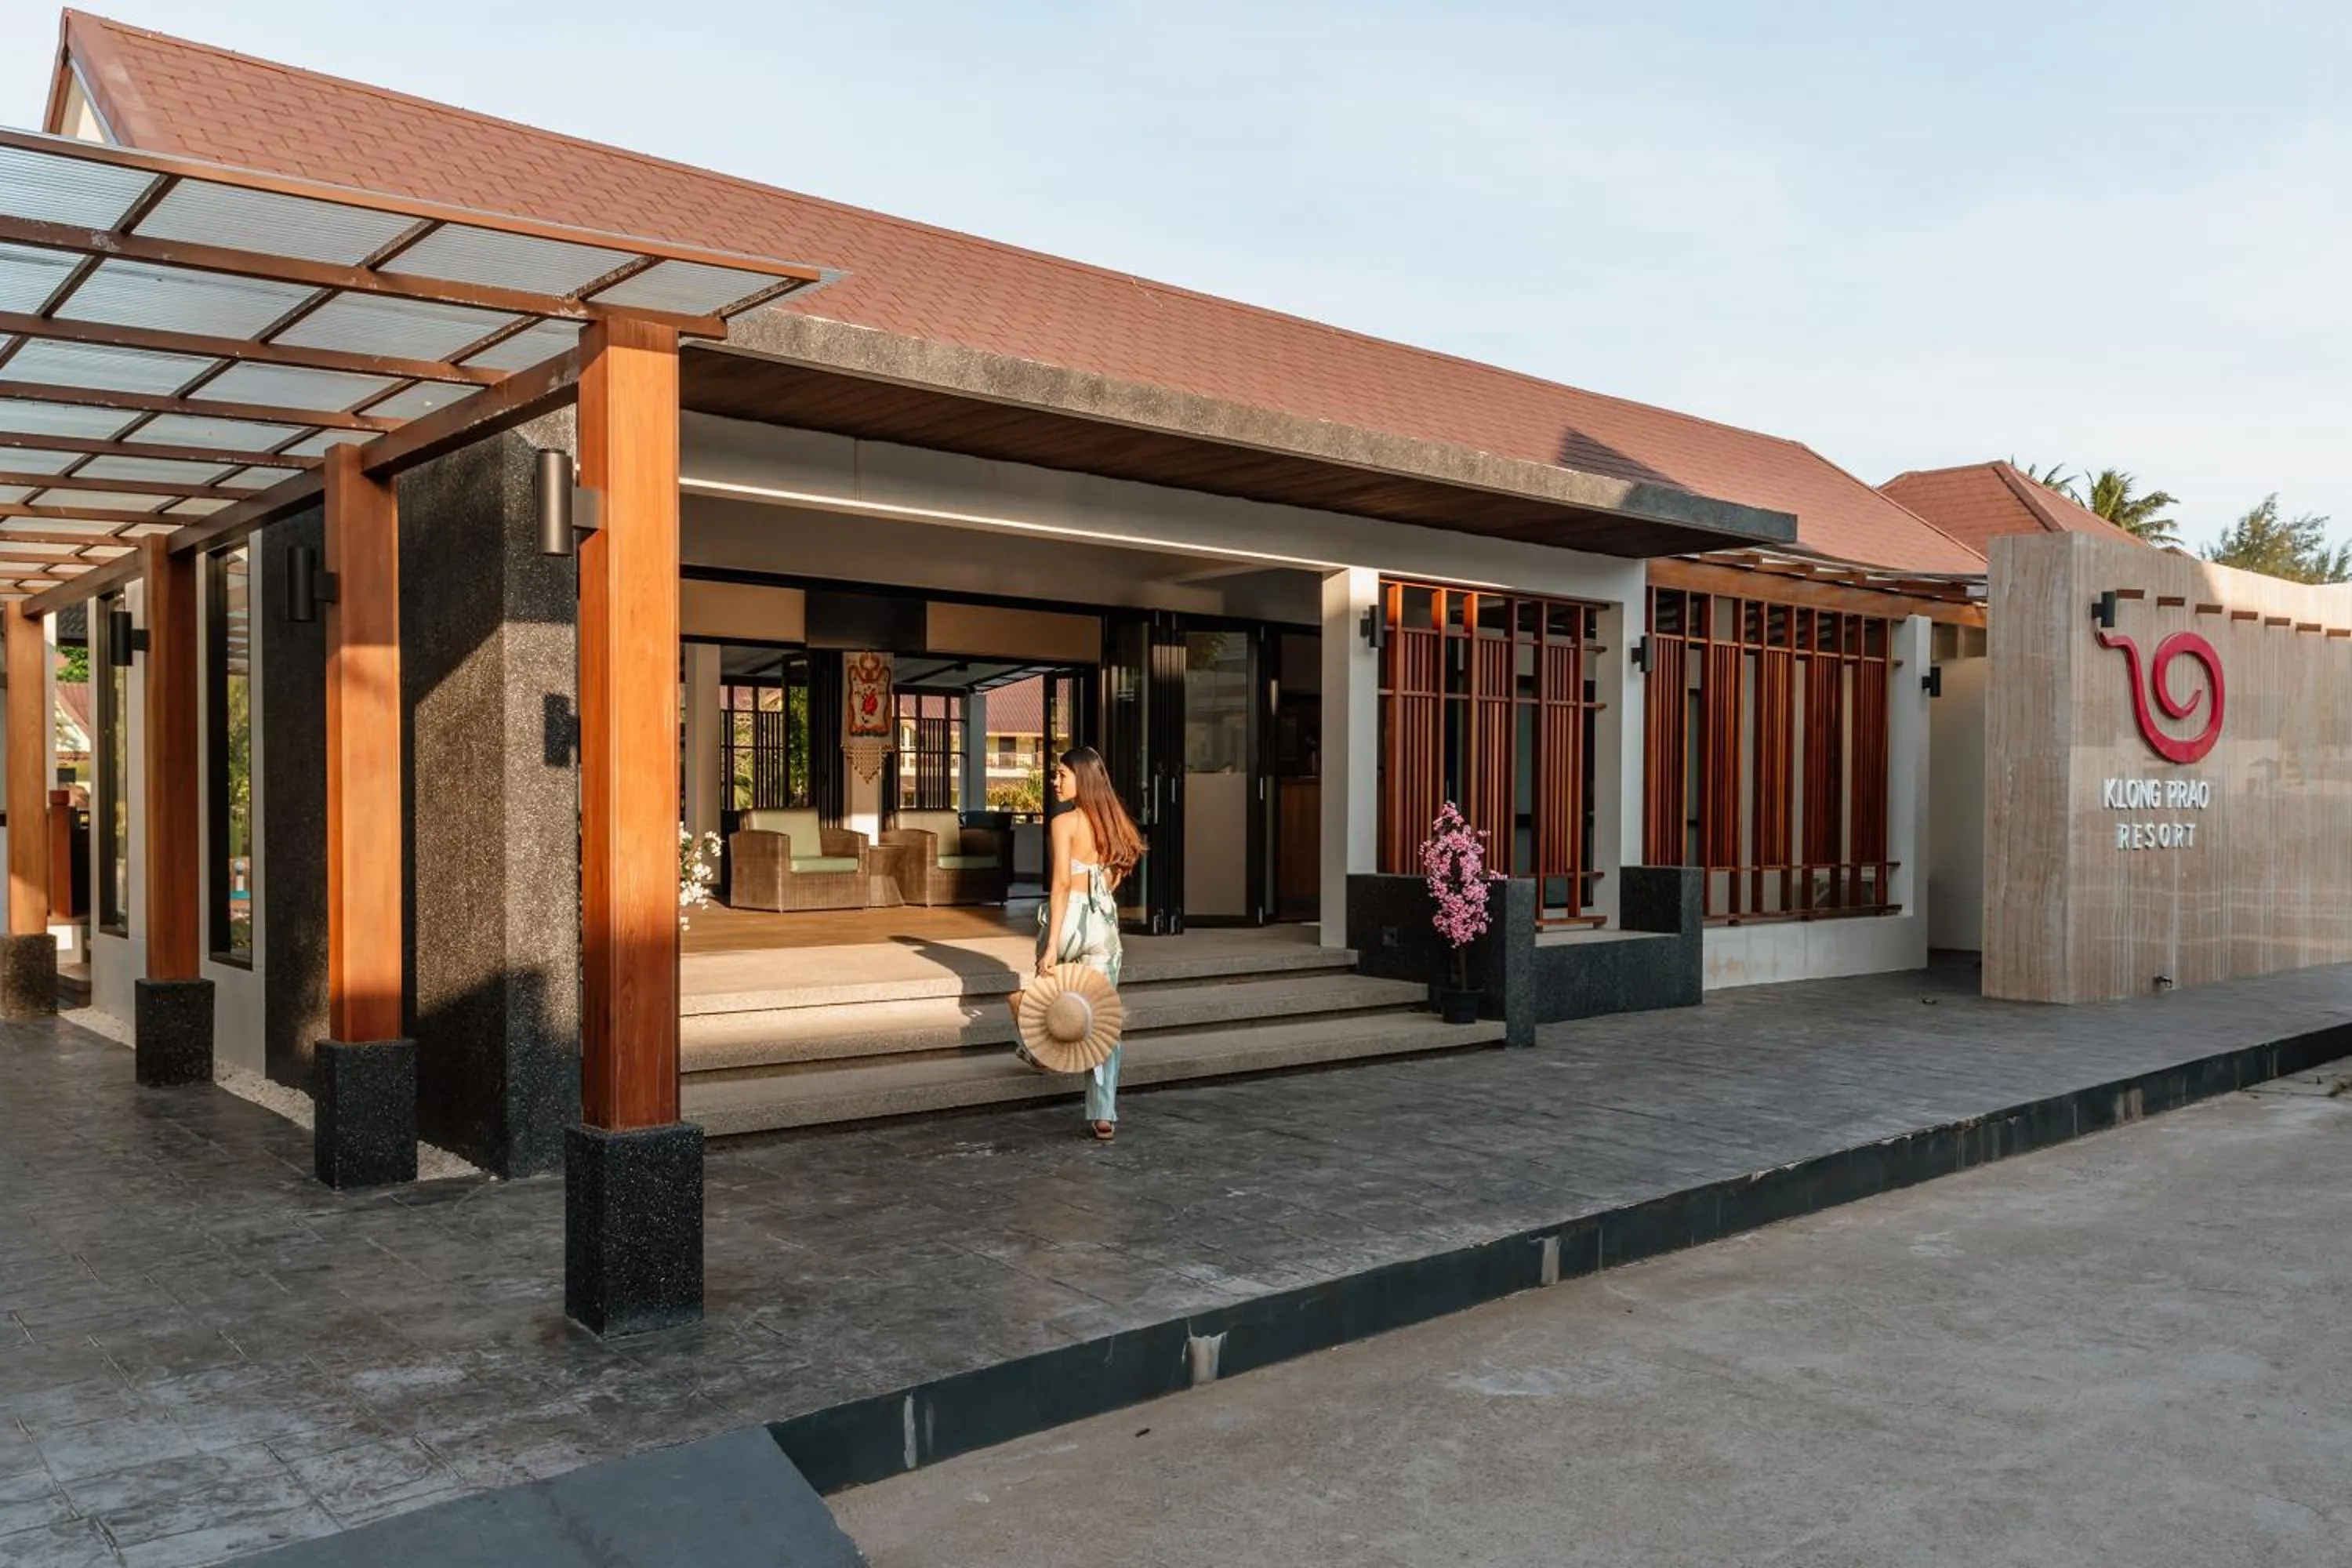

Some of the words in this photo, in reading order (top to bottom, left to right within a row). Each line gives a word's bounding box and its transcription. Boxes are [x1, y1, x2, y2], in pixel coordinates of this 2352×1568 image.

[2103, 778, 2161, 808] KLONG
[2164, 779, 2209, 808] PRAO
[2116, 822, 2195, 849] RESORT
